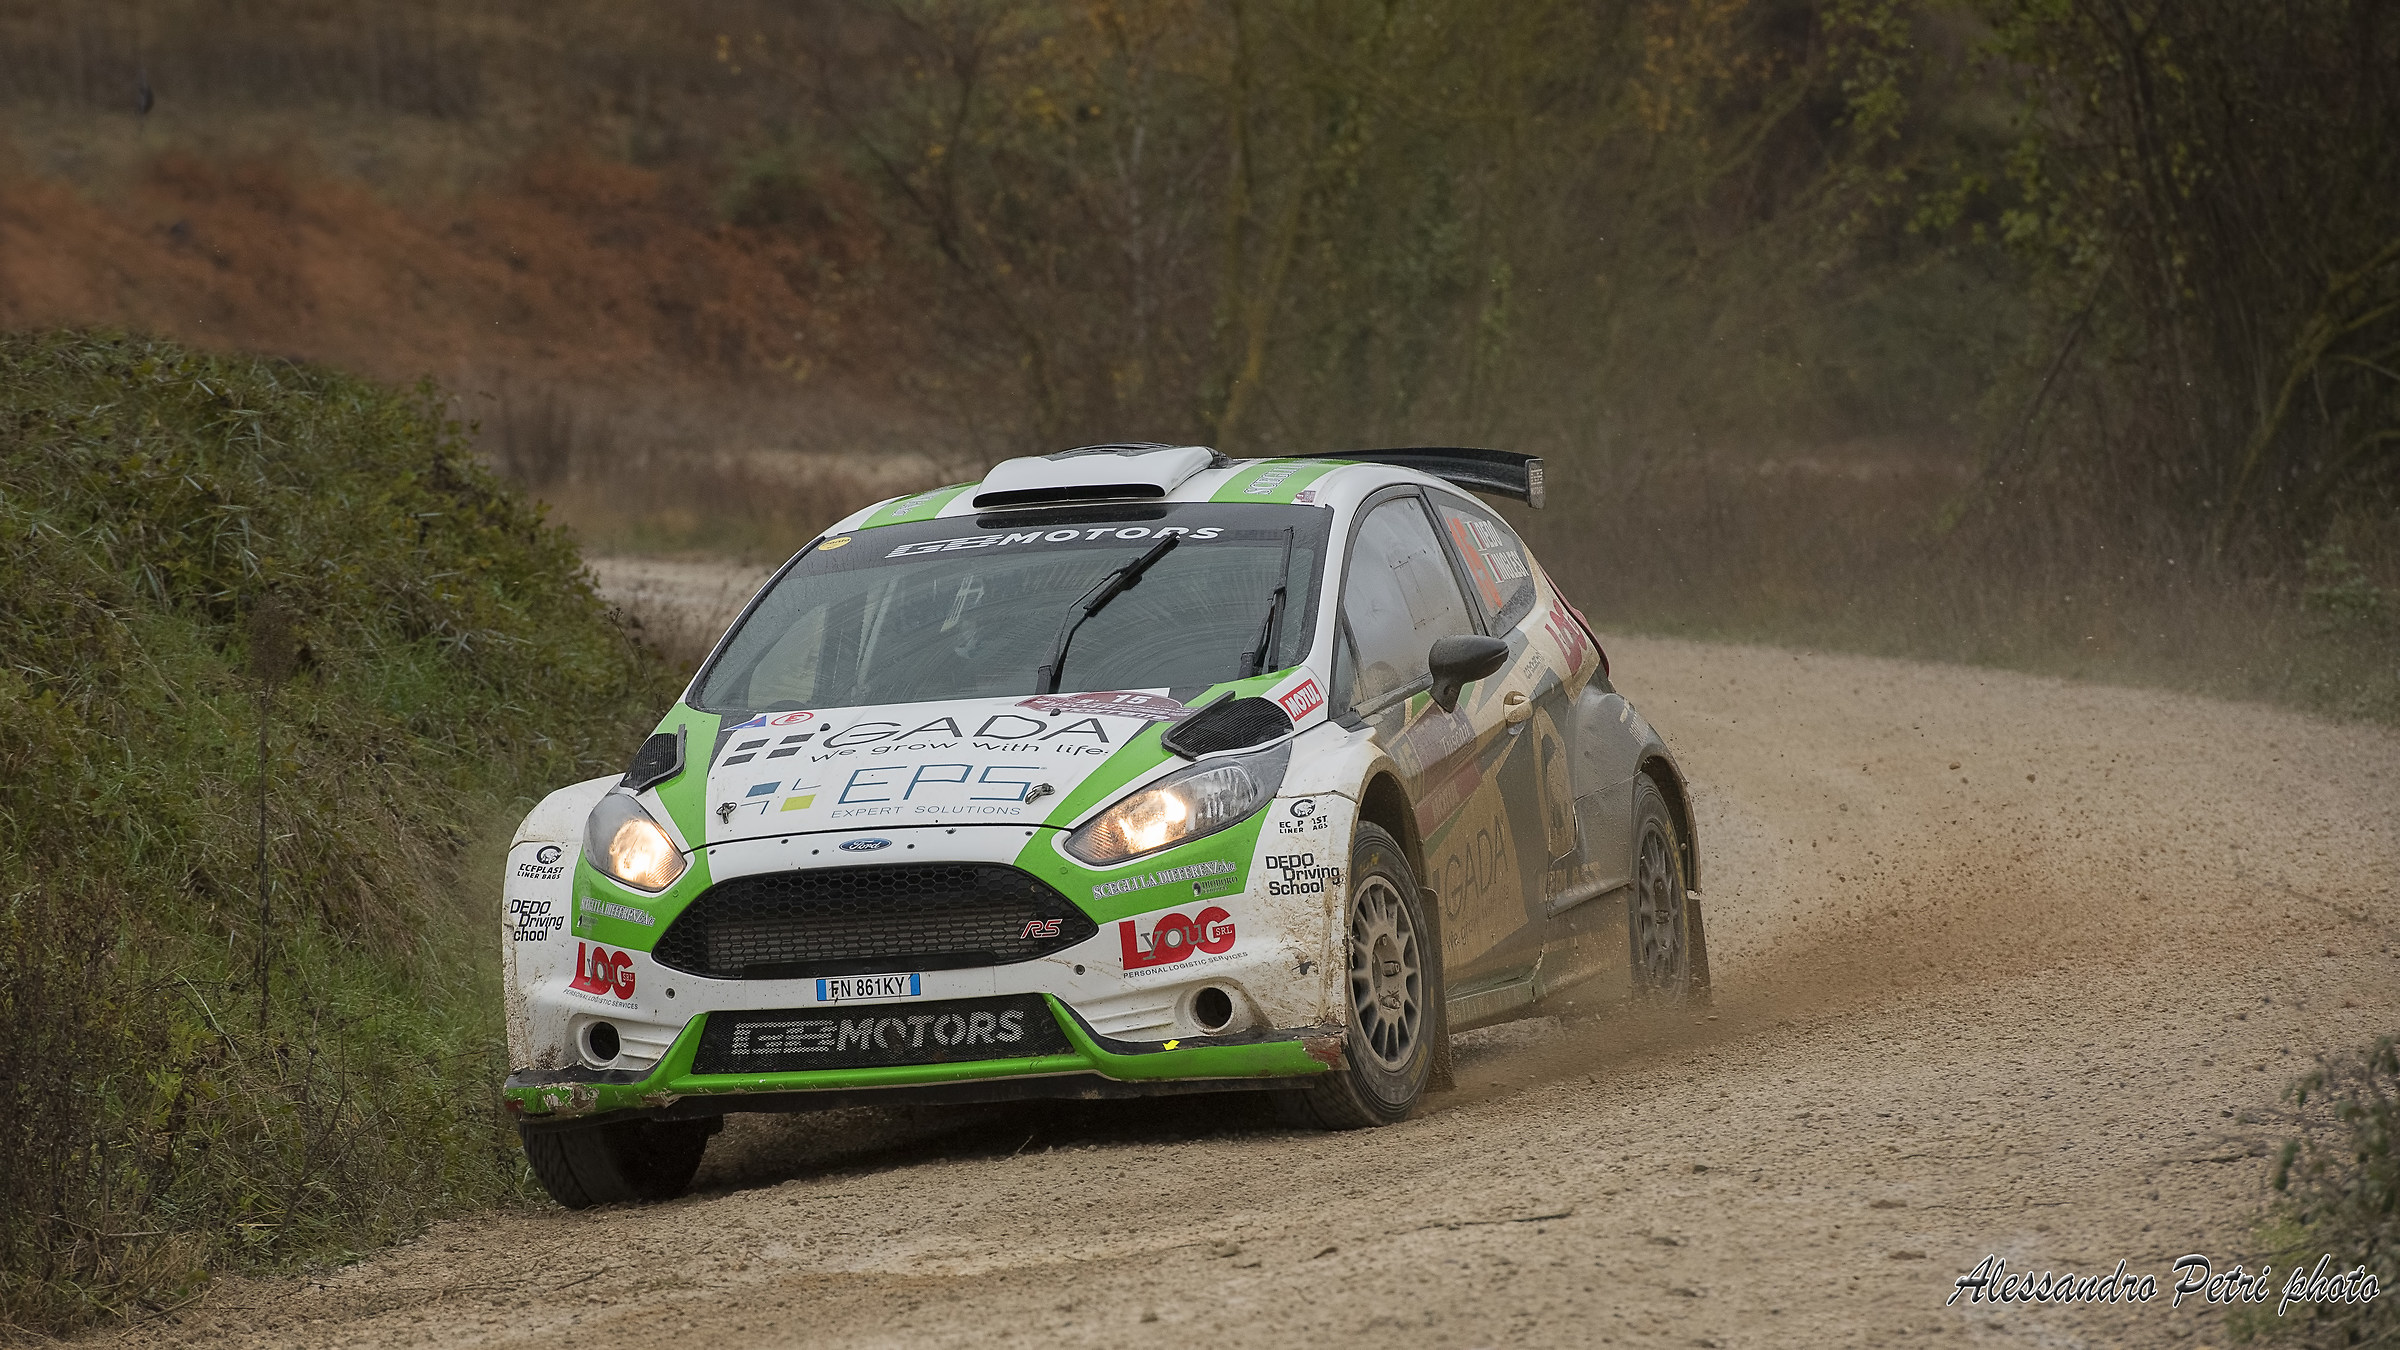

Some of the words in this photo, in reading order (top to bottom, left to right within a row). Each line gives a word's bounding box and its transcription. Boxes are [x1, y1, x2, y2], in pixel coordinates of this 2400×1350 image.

[1112, 694, 1153, 705] 15
[1284, 683, 1321, 718] MOTUL
[823, 714, 1110, 748] GADA
[811, 749, 857, 763] we
[870, 741, 959, 756] grow
[973, 742, 1040, 753] with
[838, 763, 1041, 805] EPS
[831, 806, 904, 819] EXPERT
[914, 805, 1021, 816] SOLUTIONS
[1265, 853, 1315, 869] DEDO
[1444, 815, 1509, 921] GADA
[517, 870, 540, 880] LINER
[1092, 874, 1140, 900] SCEGLI
[1140, 872, 1158, 890] LA
[1282, 864, 1343, 886] Driving
[1269, 877, 1325, 896] School
[510, 899, 552, 915] DEDO
[518, 912, 565, 931] Driving
[513, 925, 549, 942] chool
[1119, 906, 1237, 971] LOG
[1140, 924, 1206, 960] you
[1215, 925, 1234, 937] SRL
[568, 941, 636, 1000] LOG
[1123, 966, 1168, 979] PERSONAL
[1168, 959, 1208, 972] LOGISTIC
[1208, 951, 1249, 964] SERVICES
[830, 979, 851, 998] FN
[856, 976, 905, 997] 861KY
[612, 1000, 639, 1011] SERVICES
